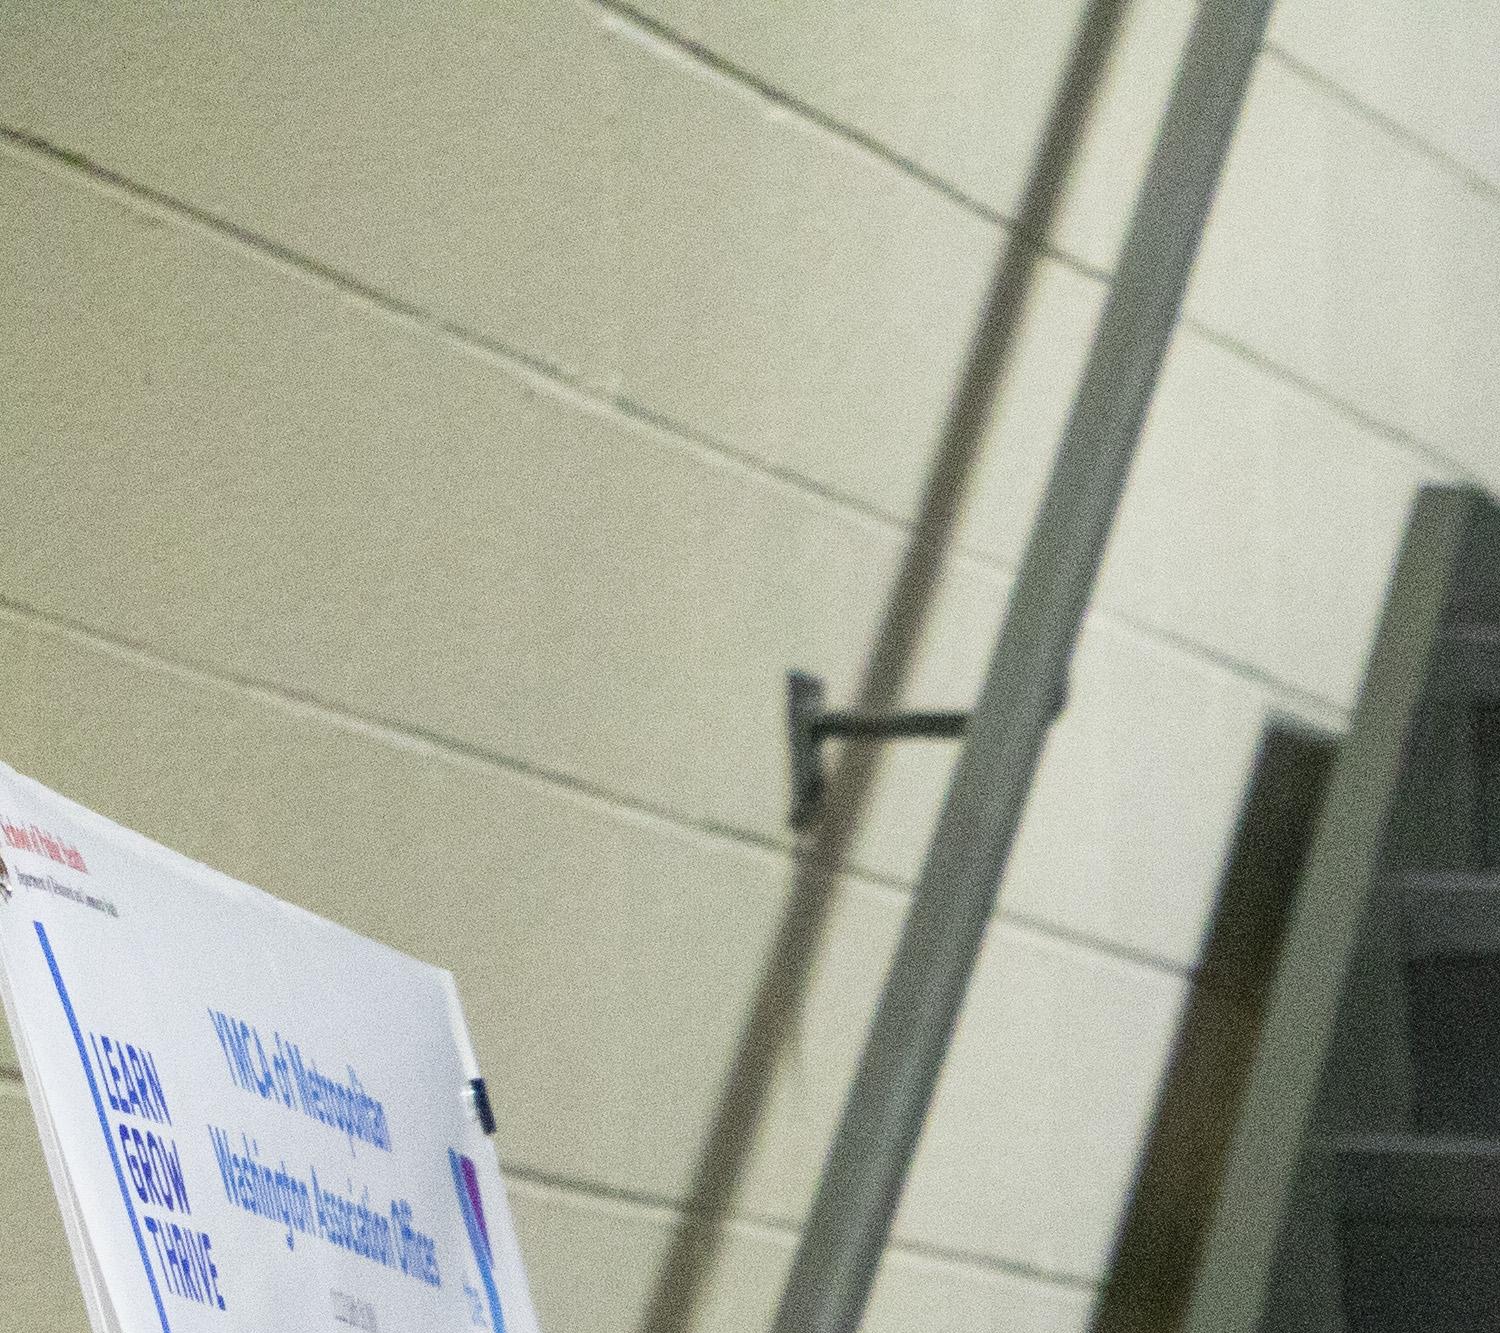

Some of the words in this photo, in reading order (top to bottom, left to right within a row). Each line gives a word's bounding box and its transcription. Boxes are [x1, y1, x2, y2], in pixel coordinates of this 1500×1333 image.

[88, 1031, 170, 1127] LEARN
[207, 1008, 280, 1102] YMCA
[272, 1031, 295, 1109] of
[284, 1040, 393, 1156] Metropolitan
[118, 1123, 192, 1217] GROW
[207, 1123, 314, 1252] Washington
[309, 1164, 395, 1267] Association
[145, 1215, 228, 1313] THRIVE
